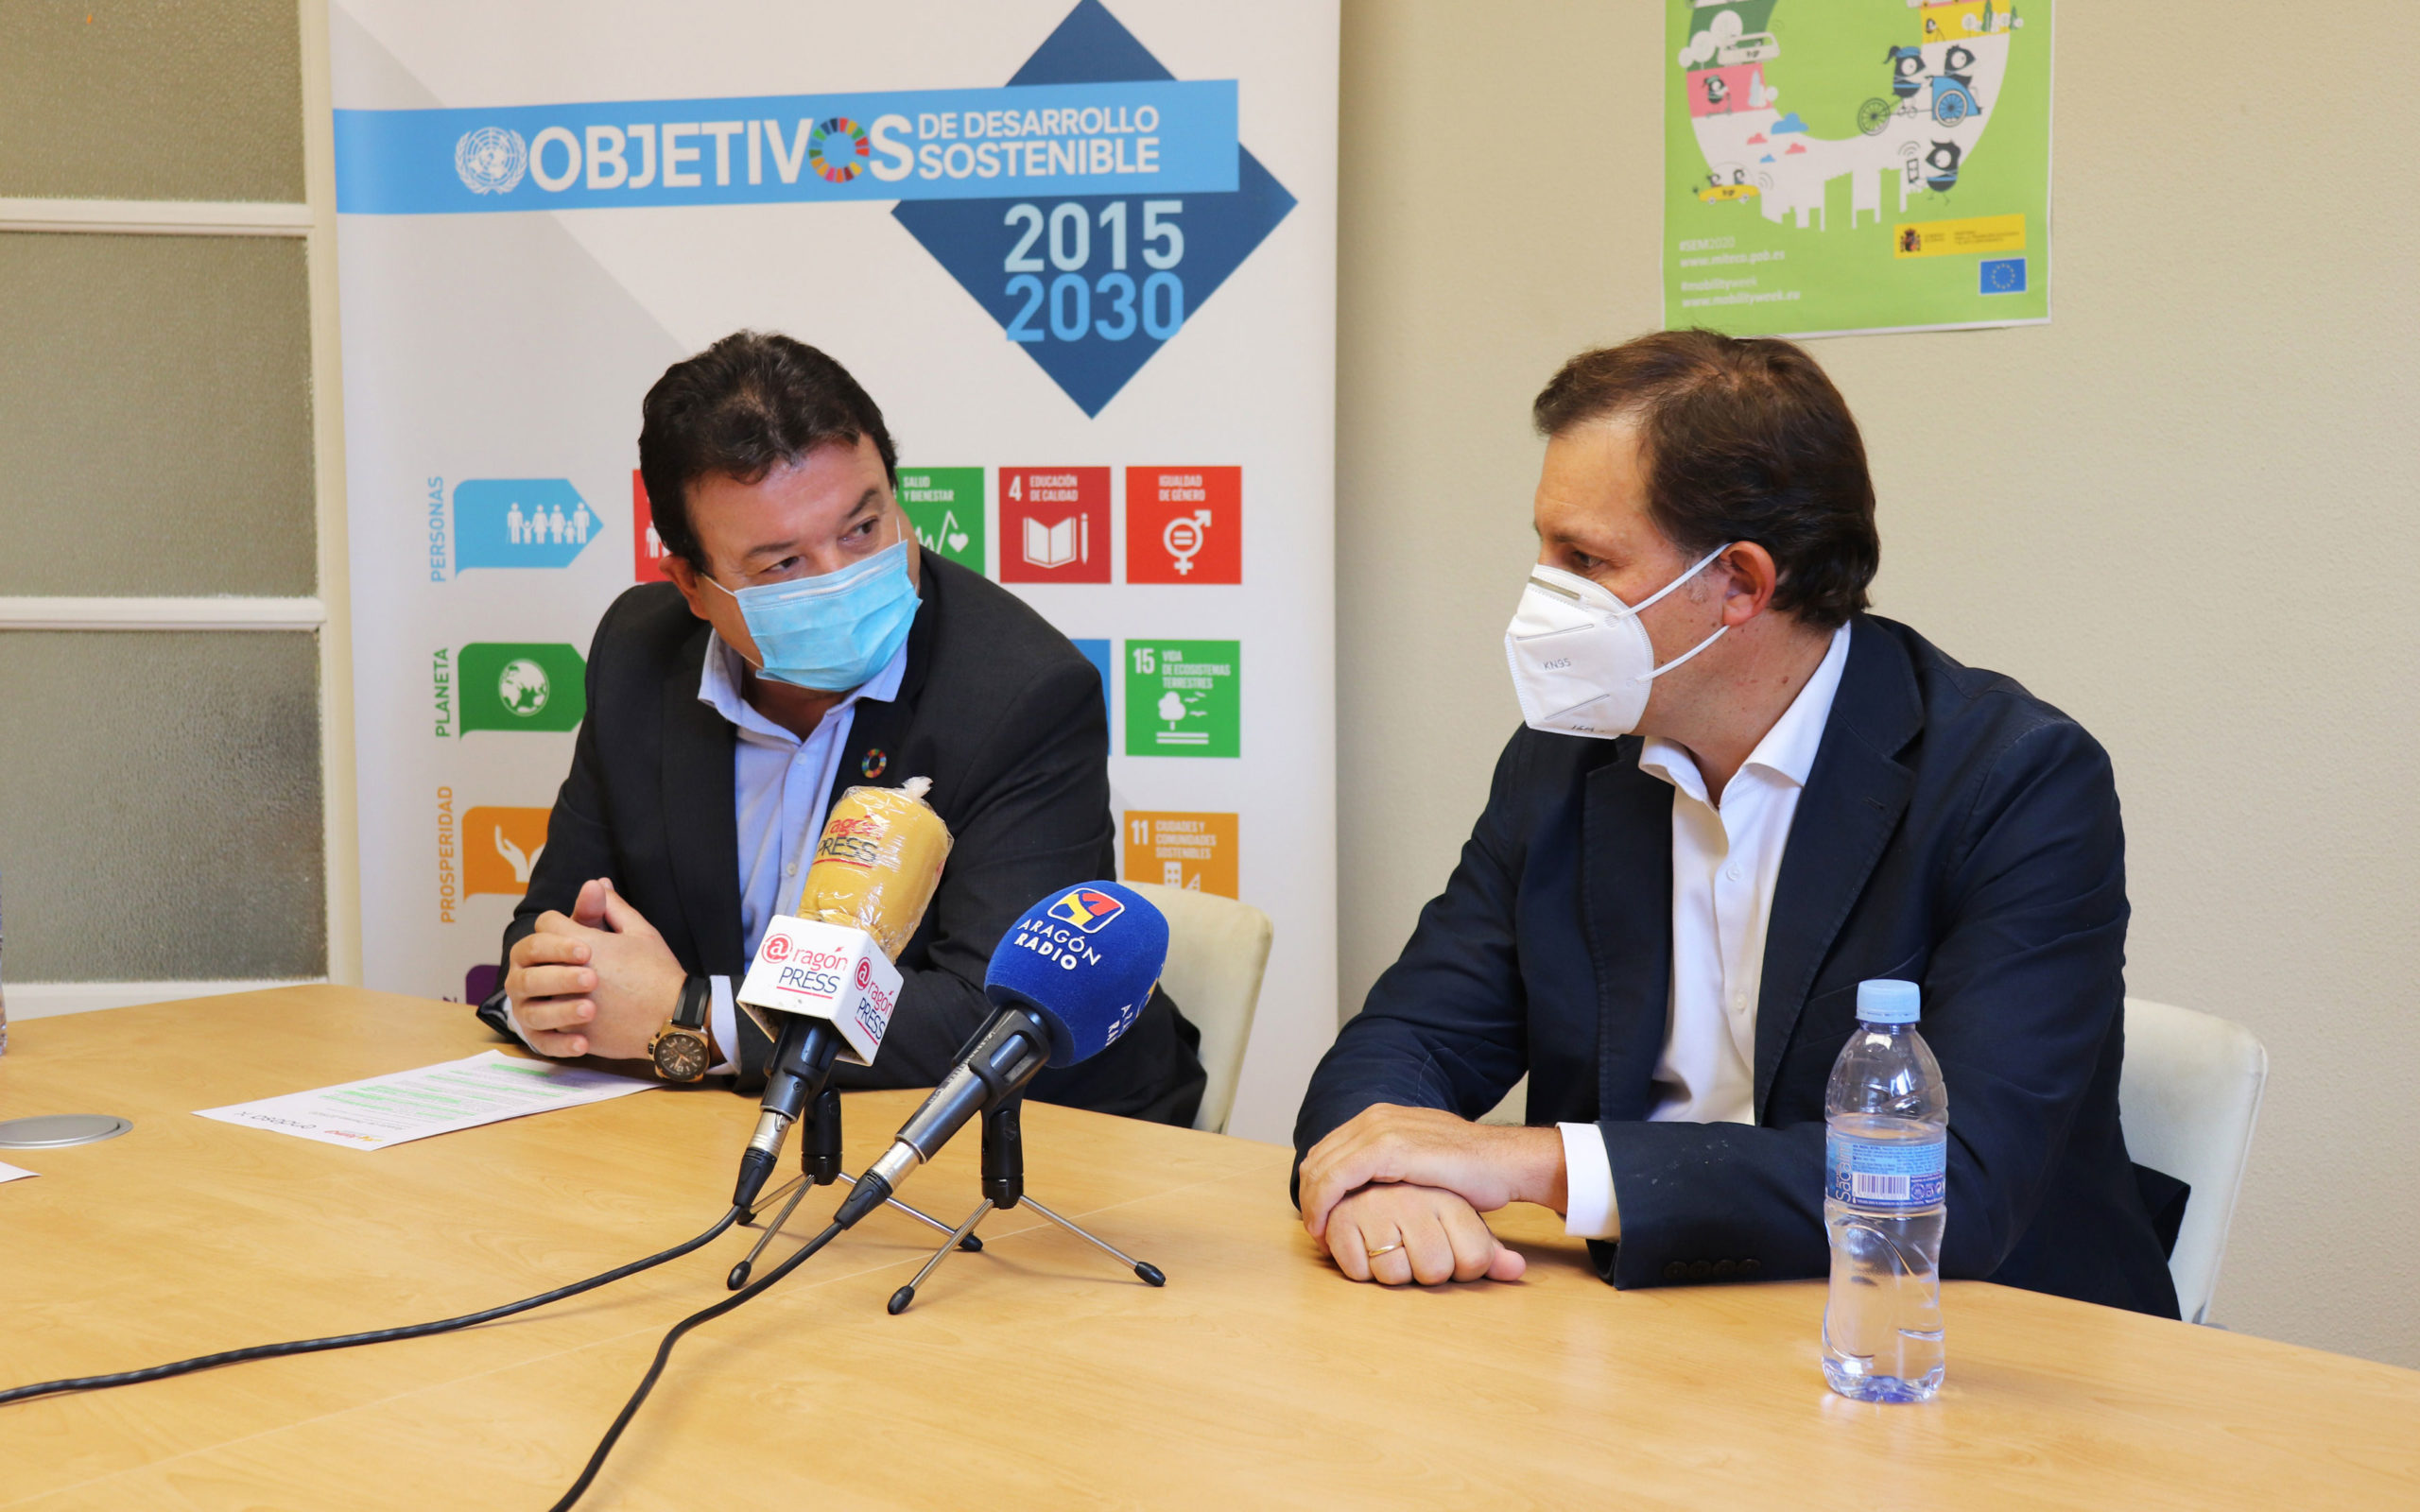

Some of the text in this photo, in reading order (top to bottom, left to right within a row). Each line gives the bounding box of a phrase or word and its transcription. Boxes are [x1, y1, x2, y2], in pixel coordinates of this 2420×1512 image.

[919, 105, 1160, 140] DE DESARROLLO
[529, 112, 915, 193] OBJETIVOS
[918, 137, 1160, 180] SOSTENIBLE
[1004, 200, 1184, 272] 2015
[1005, 271, 1185, 342] 2030
[904, 475, 930, 488] SALUD
[1009, 475, 1023, 502] 4
[1029, 474, 1078, 488] EDUCACIÓN
[1159, 475, 1202, 488] IGUALDAD
[1159, 487, 1205, 502] DE GÉNERO
[904, 490, 955, 502] Y BIENESTAR
[1029, 490, 1079, 502] DE CALIDAD
[428, 475, 446, 582] PERSONAS
[1132, 648, 1155, 675] 15
[1162, 650, 1183, 662] VIDA
[1543, 658, 1571, 671] KN95
[1162, 663, 1231, 677] DE ECOSISTEMAS
[1162, 677, 1213, 689] TERRESTRES
[434, 647, 451, 737] PLANETA
[1132, 819, 1149, 845] 11
[438, 785, 457, 924] PROSPERIDAD
[1014, 932, 1077, 971] RADIO
[1017, 919, 1101, 966] ARAGÓN
[779, 967, 840, 994] PRESS
[856, 997, 886, 1040] PRESS
